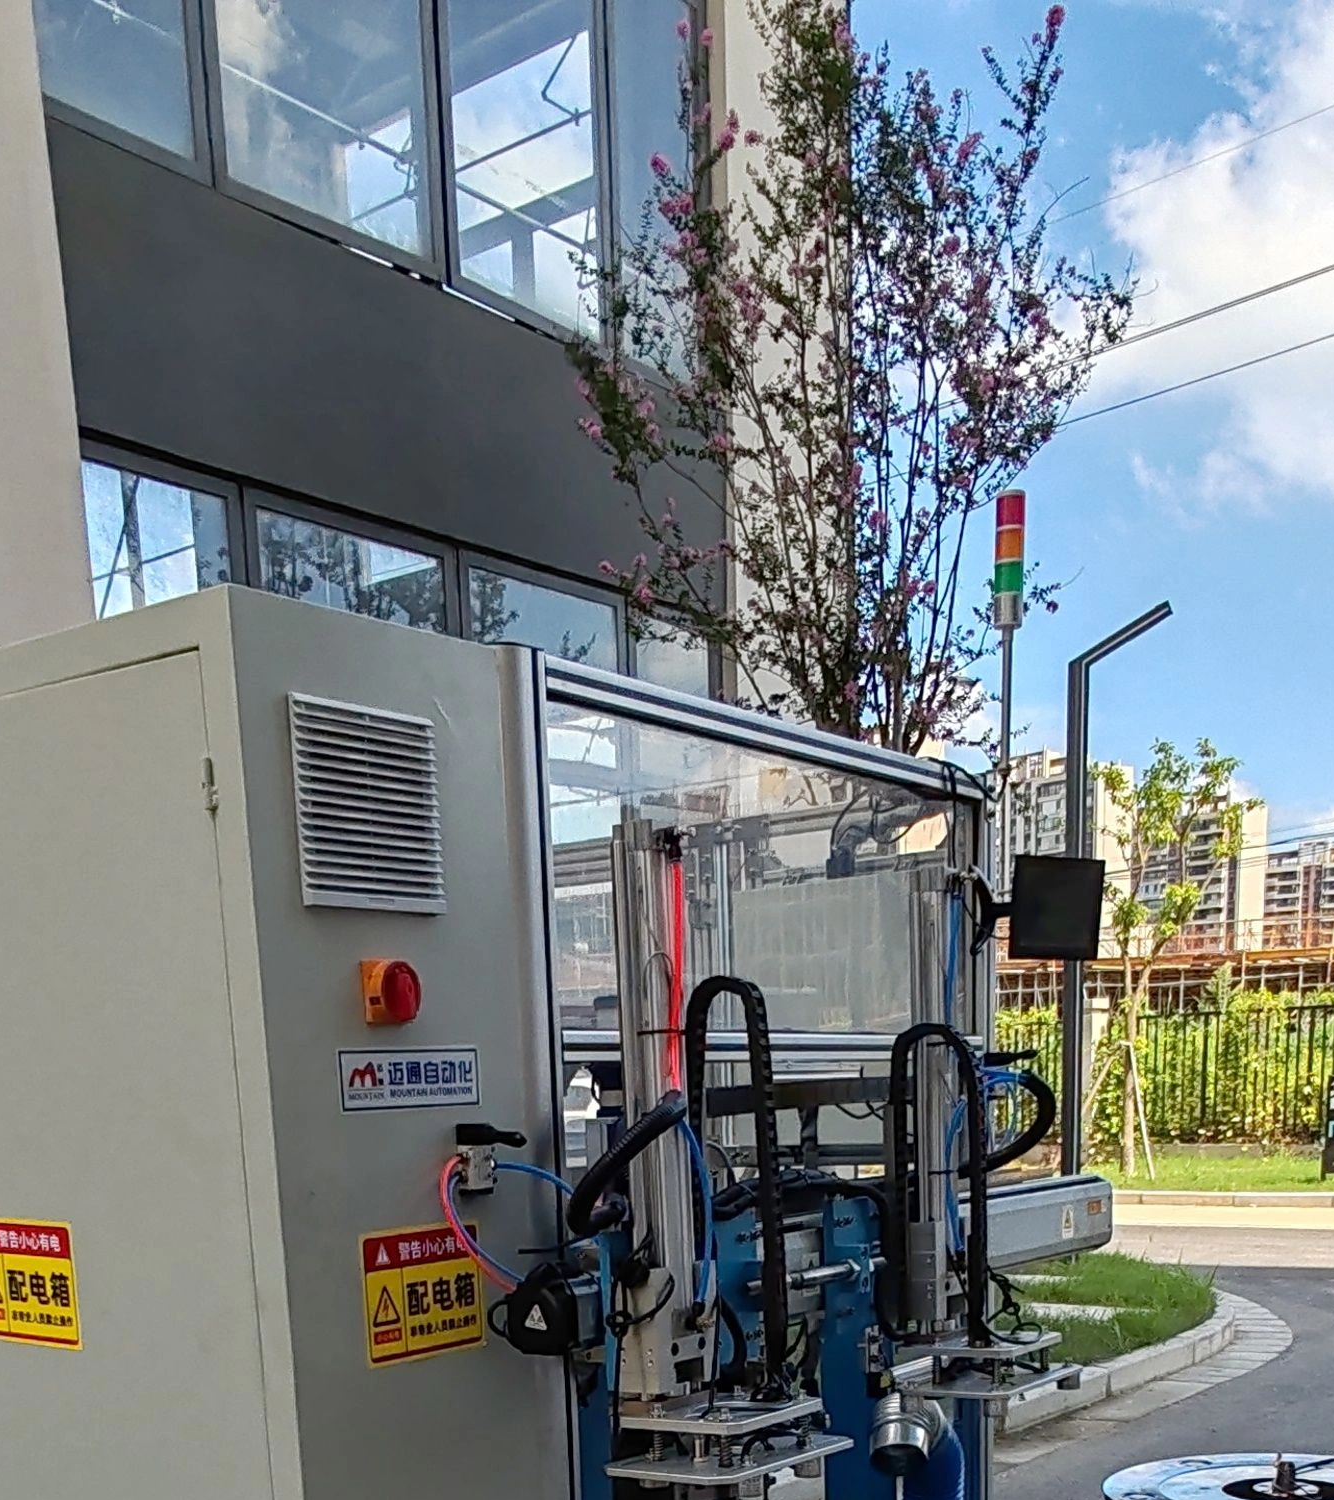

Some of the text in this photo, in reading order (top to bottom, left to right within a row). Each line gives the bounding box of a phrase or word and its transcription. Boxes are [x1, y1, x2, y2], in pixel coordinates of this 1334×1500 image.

[388, 1060, 474, 1085] 迈通自动化
[390, 1086, 473, 1099] MOUNTAIN AUTOMATION
[7, 1269, 71, 1308] 配电箱
[406, 1272, 475, 1316] 配电箱
